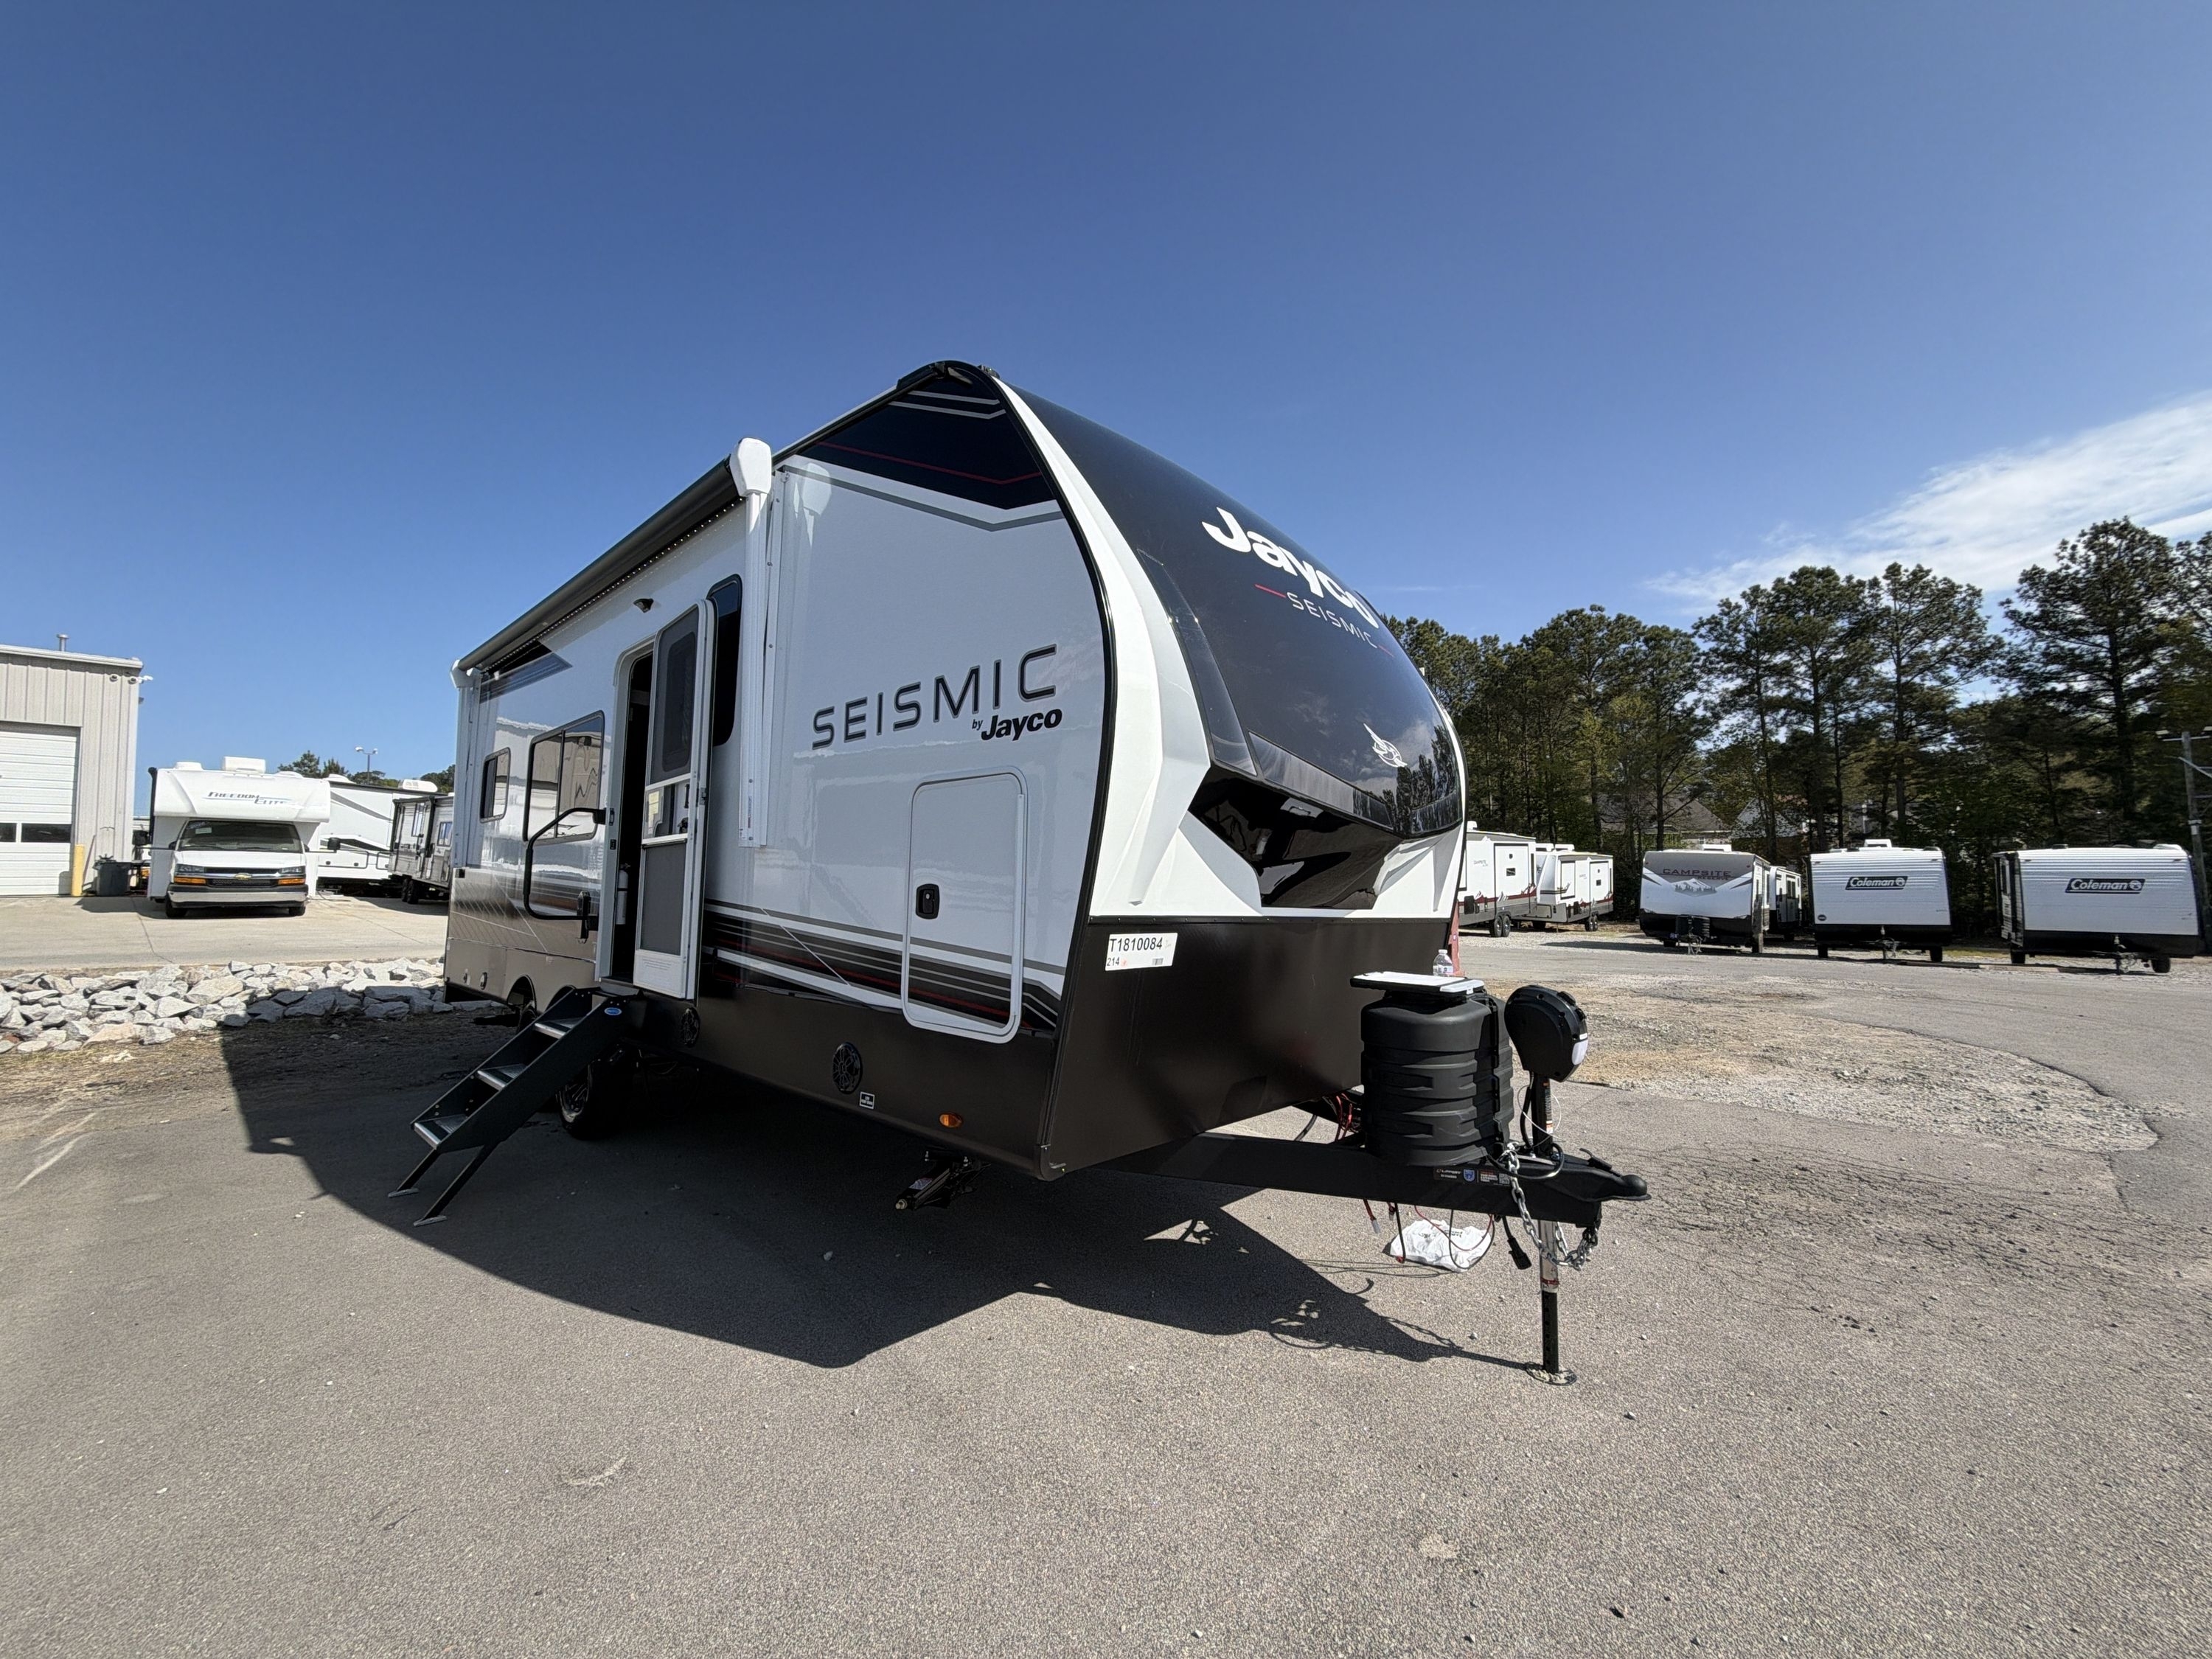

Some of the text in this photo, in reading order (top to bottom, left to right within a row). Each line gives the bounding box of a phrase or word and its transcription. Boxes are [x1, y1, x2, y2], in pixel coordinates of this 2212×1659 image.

[1201, 507, 1379, 628] Jayco
[1287, 592, 1378, 649] SEISMIC
[812, 644, 1057, 751] SEISMIC
[972, 709, 1062, 741] by Jayco
[1663, 869, 1731, 877] CAMPSITE
[1850, 877, 1894, 887] Coleman
[2070, 879, 2128, 890] Coleman
[1110, 937, 1163, 952] T1810084
[1107, 957, 1120, 967] 214
